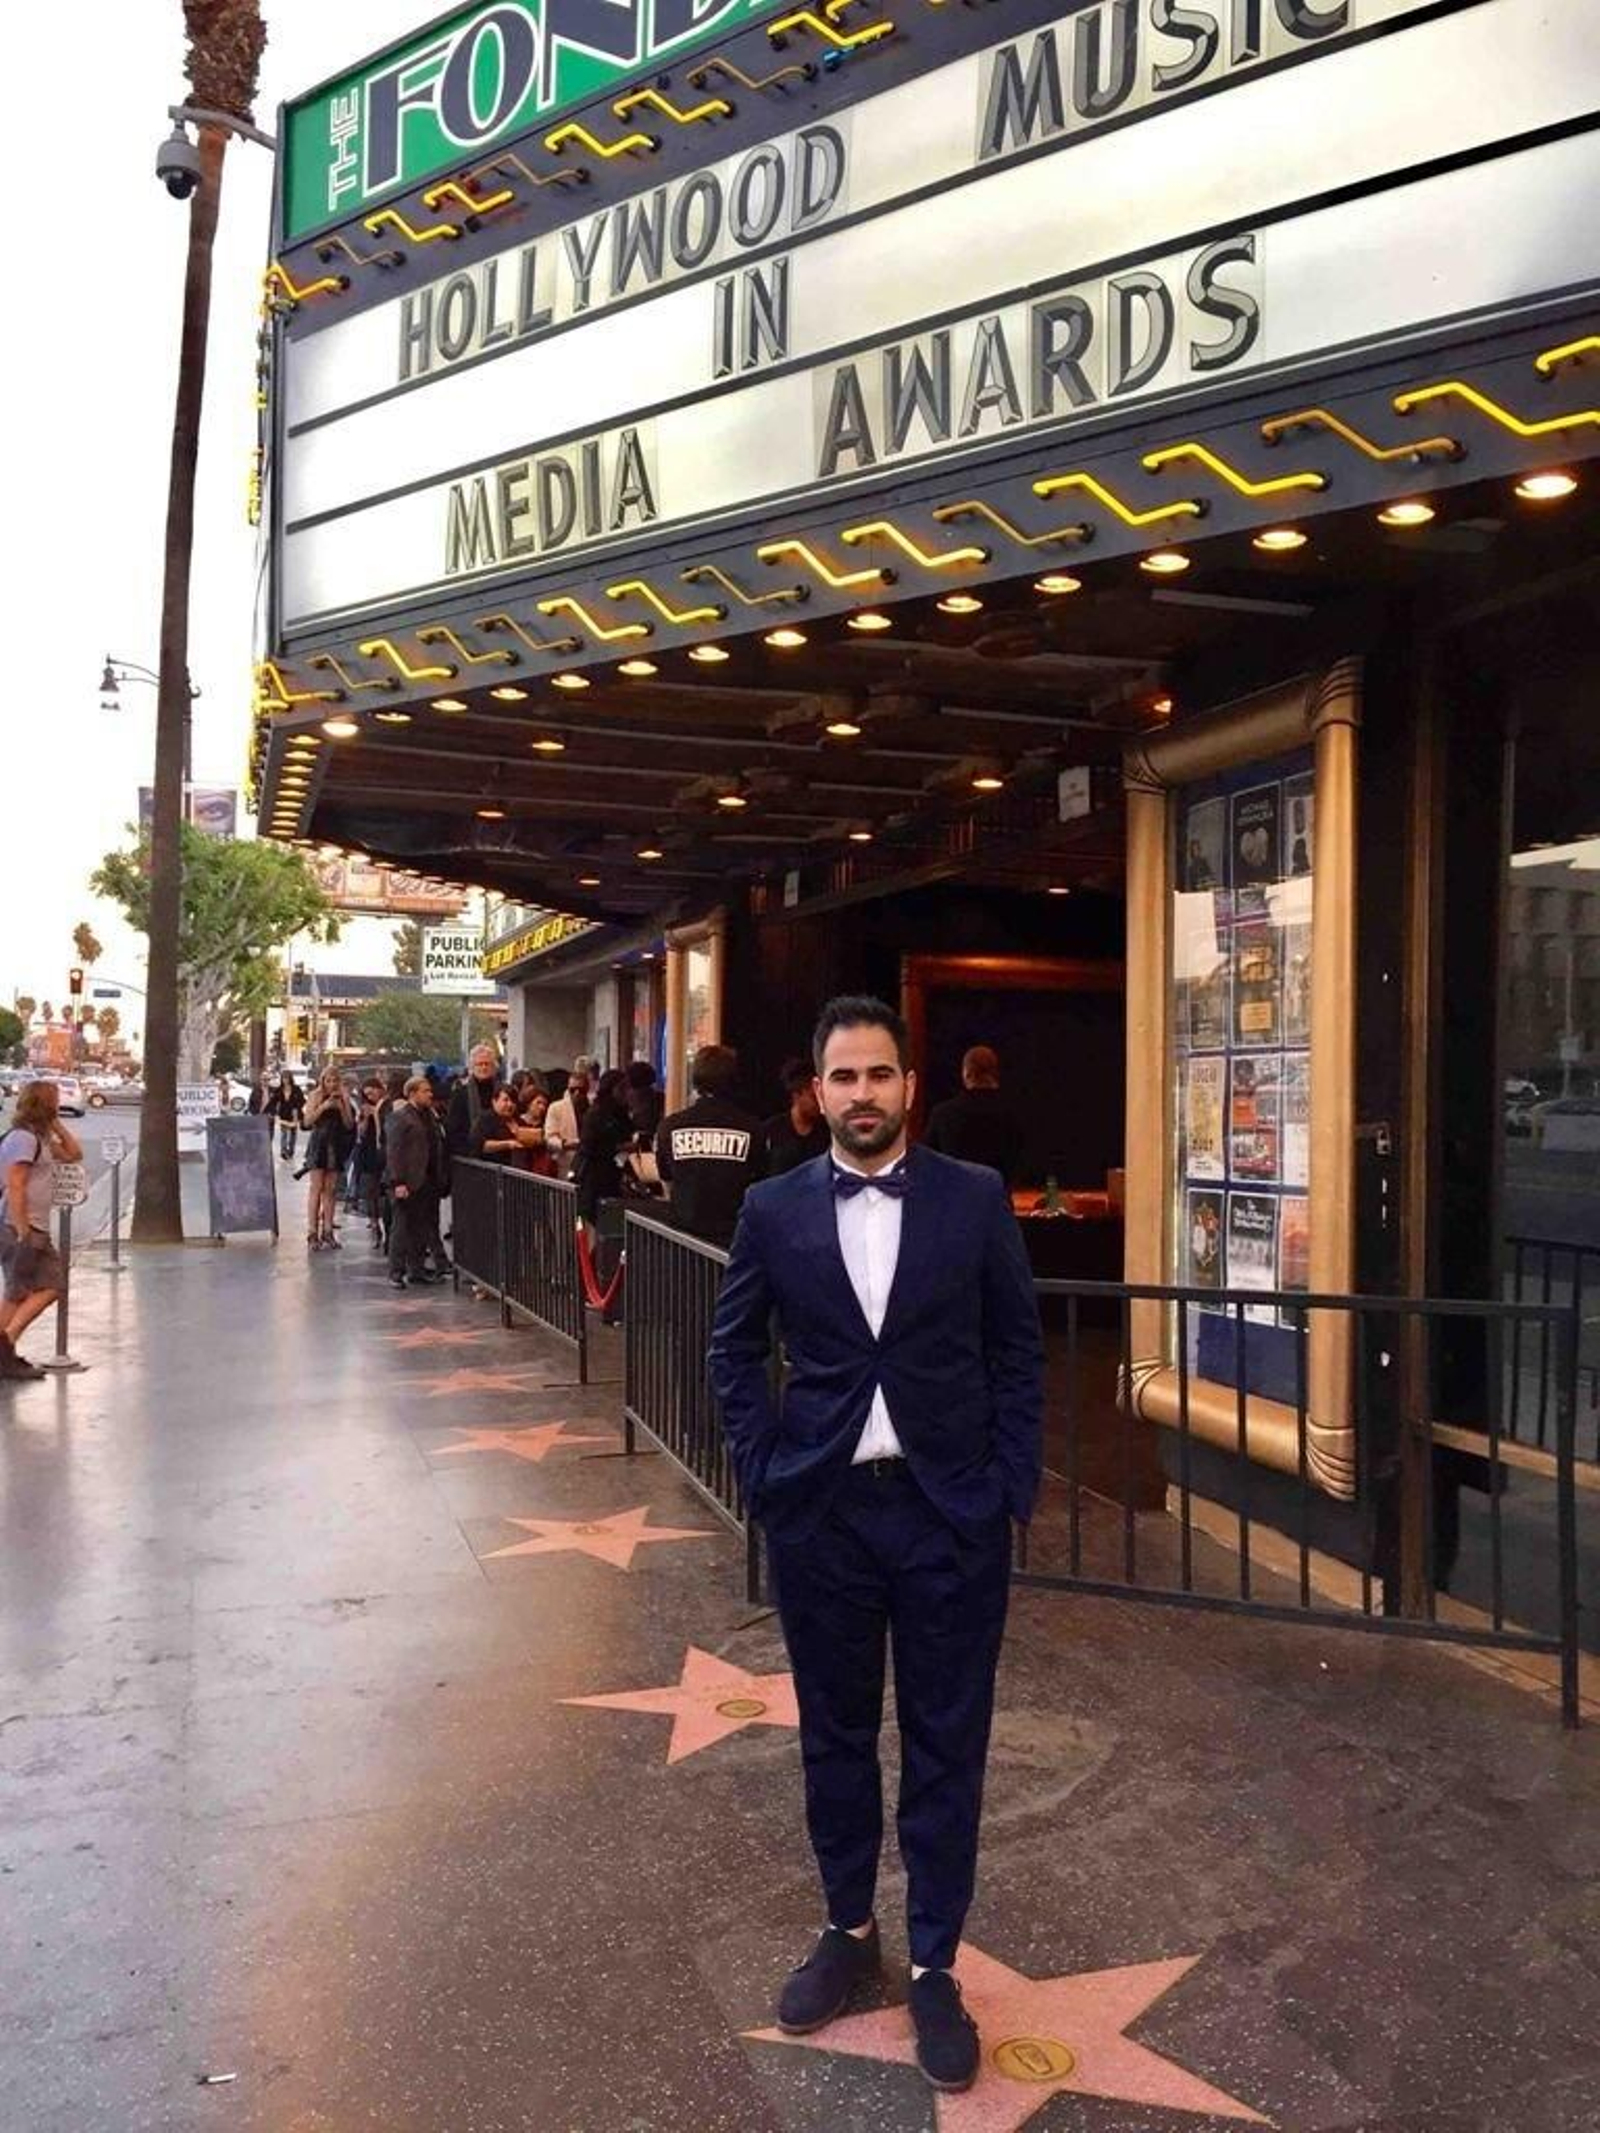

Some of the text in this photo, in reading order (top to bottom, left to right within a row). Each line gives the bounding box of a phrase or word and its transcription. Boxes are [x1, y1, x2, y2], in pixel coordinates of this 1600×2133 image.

[328, 87, 359, 211] THE
[361, 0, 768, 198] FON
[400, 123, 846, 380] HOLLYWOOD
[712, 257, 791, 380] IN
[446, 233, 1260, 575] MEDIA AWARDS
[425, 953, 484, 969] PARKIN
[177, 1089, 216, 1101] UBLIC
[177, 1104, 219, 1116] ARKING
[675, 1131, 746, 1157] SECURITY
